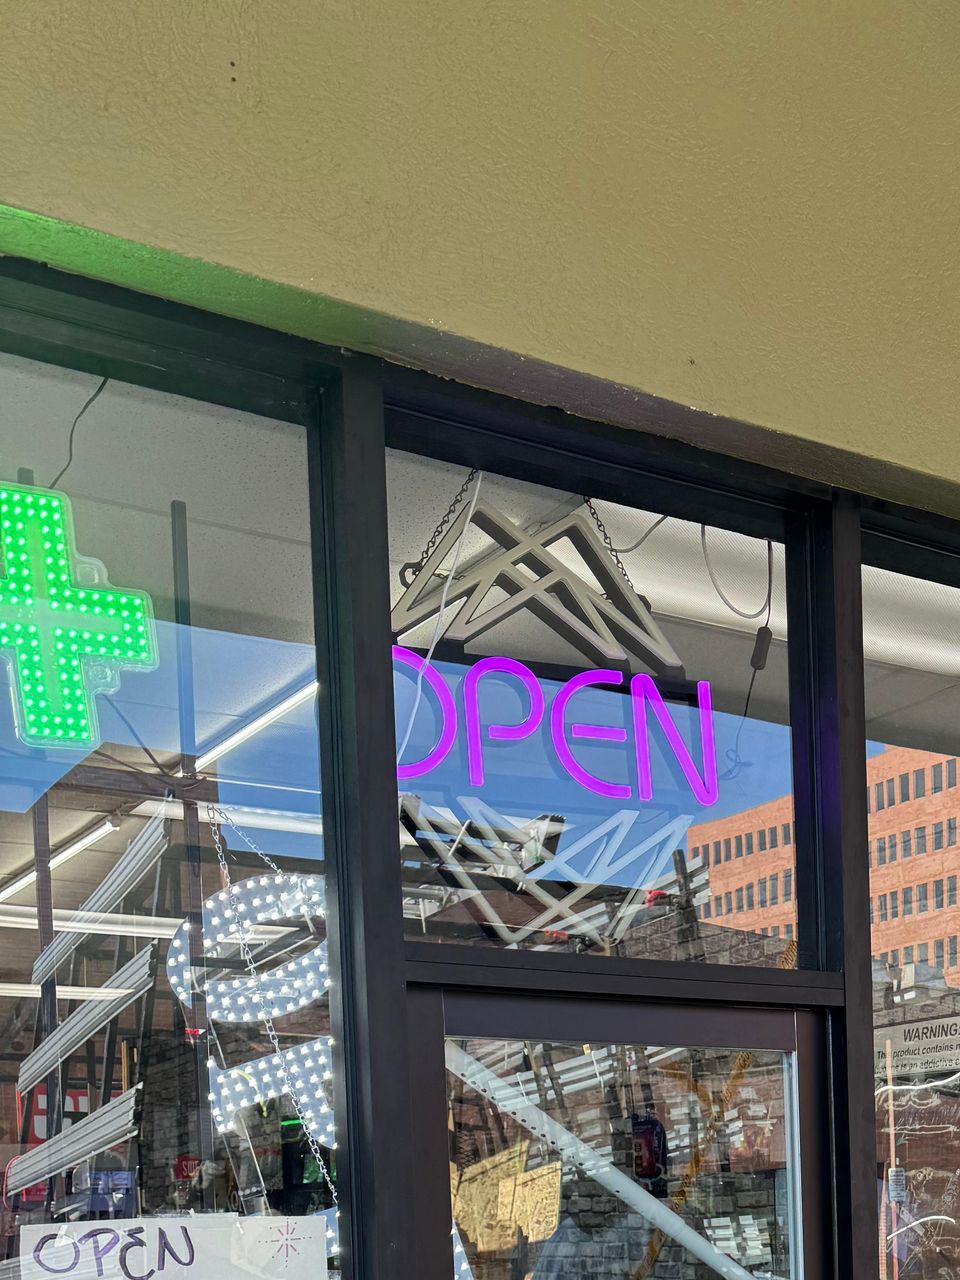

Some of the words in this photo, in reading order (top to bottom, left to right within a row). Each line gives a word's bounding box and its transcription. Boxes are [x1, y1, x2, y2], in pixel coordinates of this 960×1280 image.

[391, 645, 719, 806] OPEN
[893, 1046, 920, 1060] product
[922, 1042, 954, 1055] contains
[33, 1224, 195, 1280] OPEN
